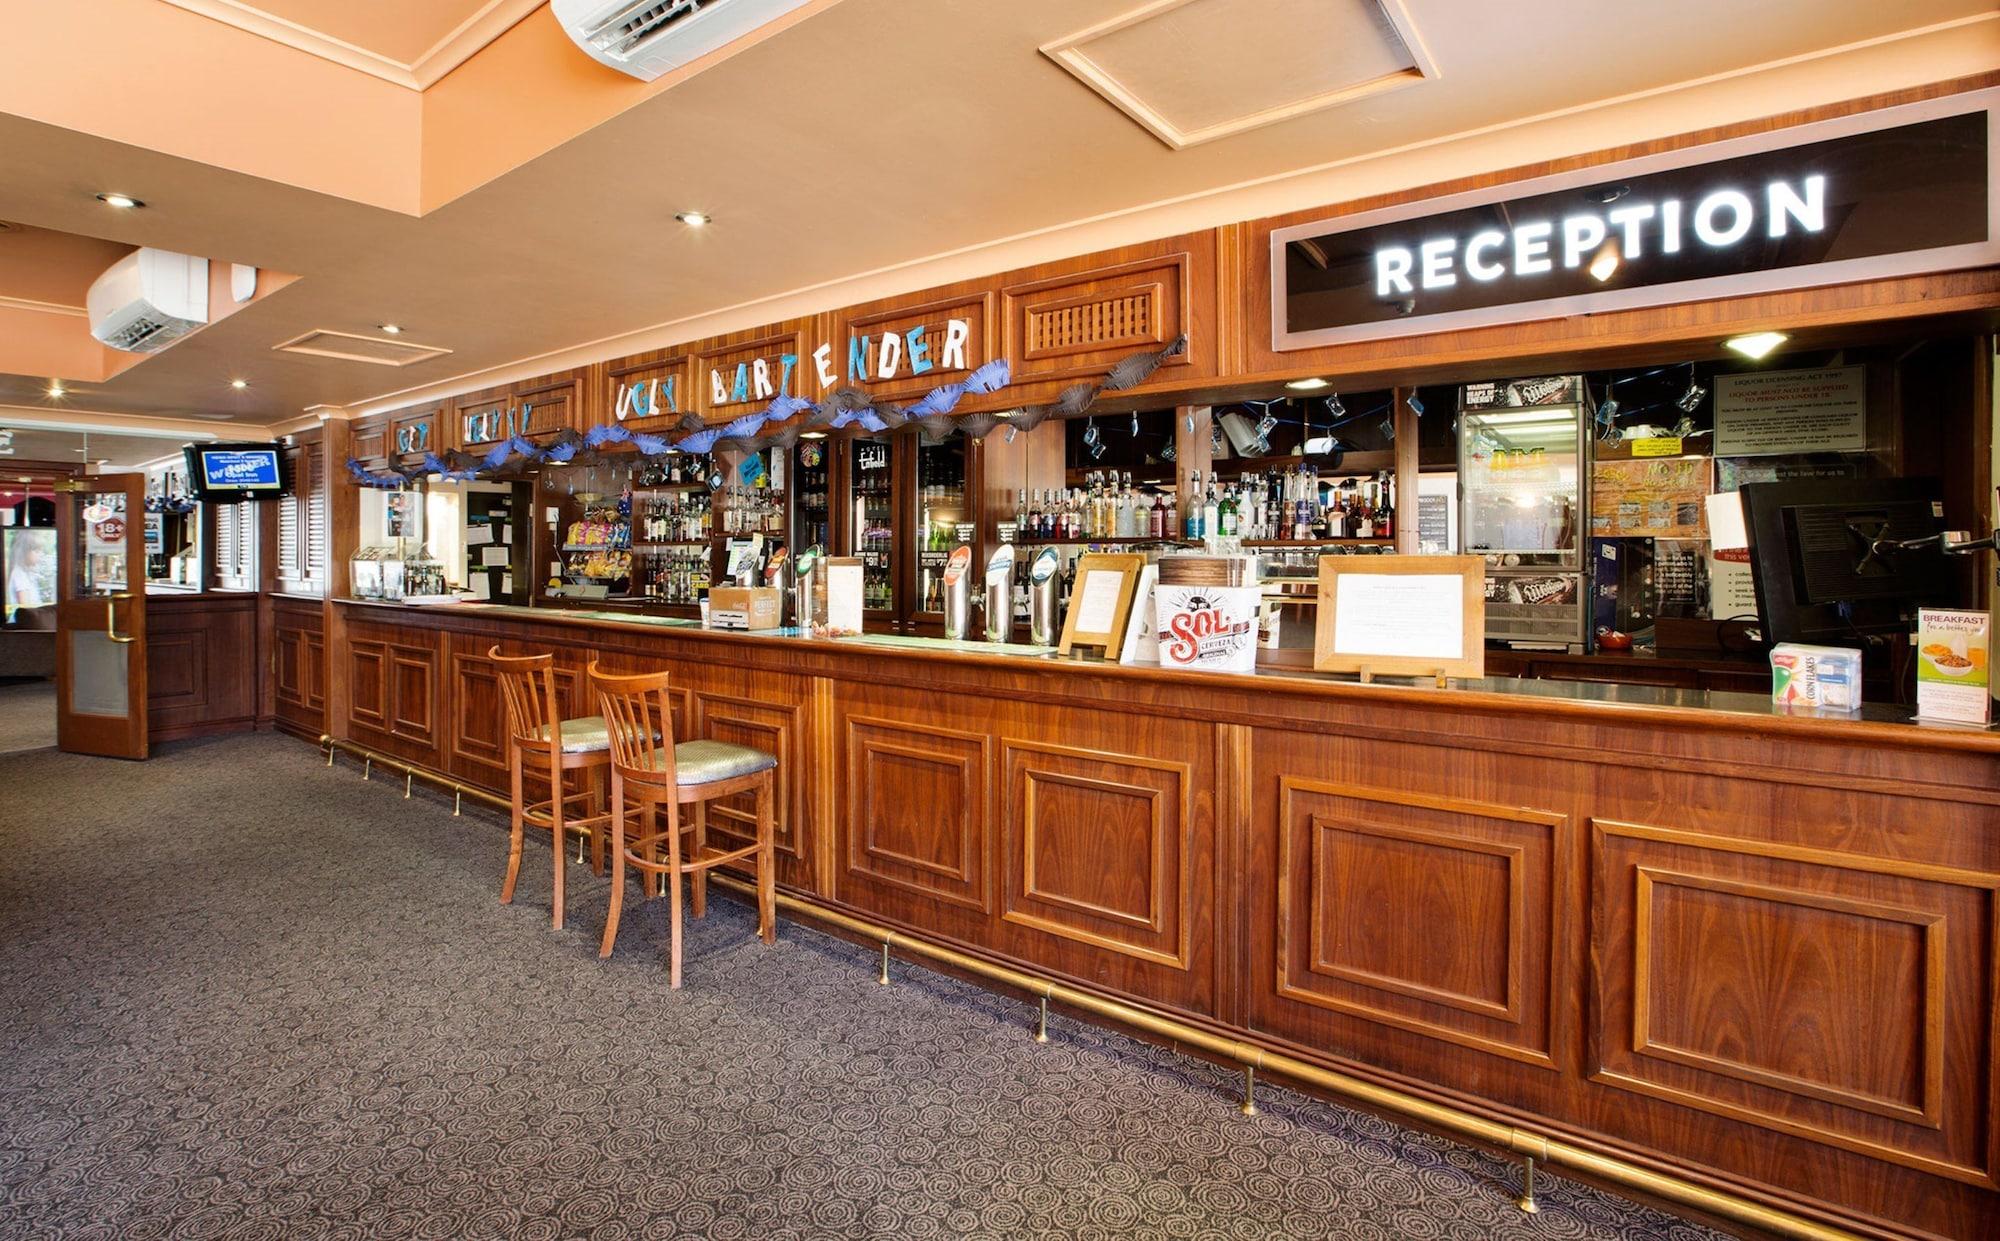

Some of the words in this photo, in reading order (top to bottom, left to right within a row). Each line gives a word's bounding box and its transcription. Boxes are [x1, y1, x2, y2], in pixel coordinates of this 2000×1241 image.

[1376, 176, 1825, 295] RECEPTION
[615, 375, 676, 420] UGLY
[1923, 615, 1985, 625] BREAKFAST
[1170, 608, 1230, 664] SOL
[1201, 639, 1231, 649] CERVEZA
[1806, 656, 1815, 680] FLAKES
[1806, 681, 1815, 700] CORN
